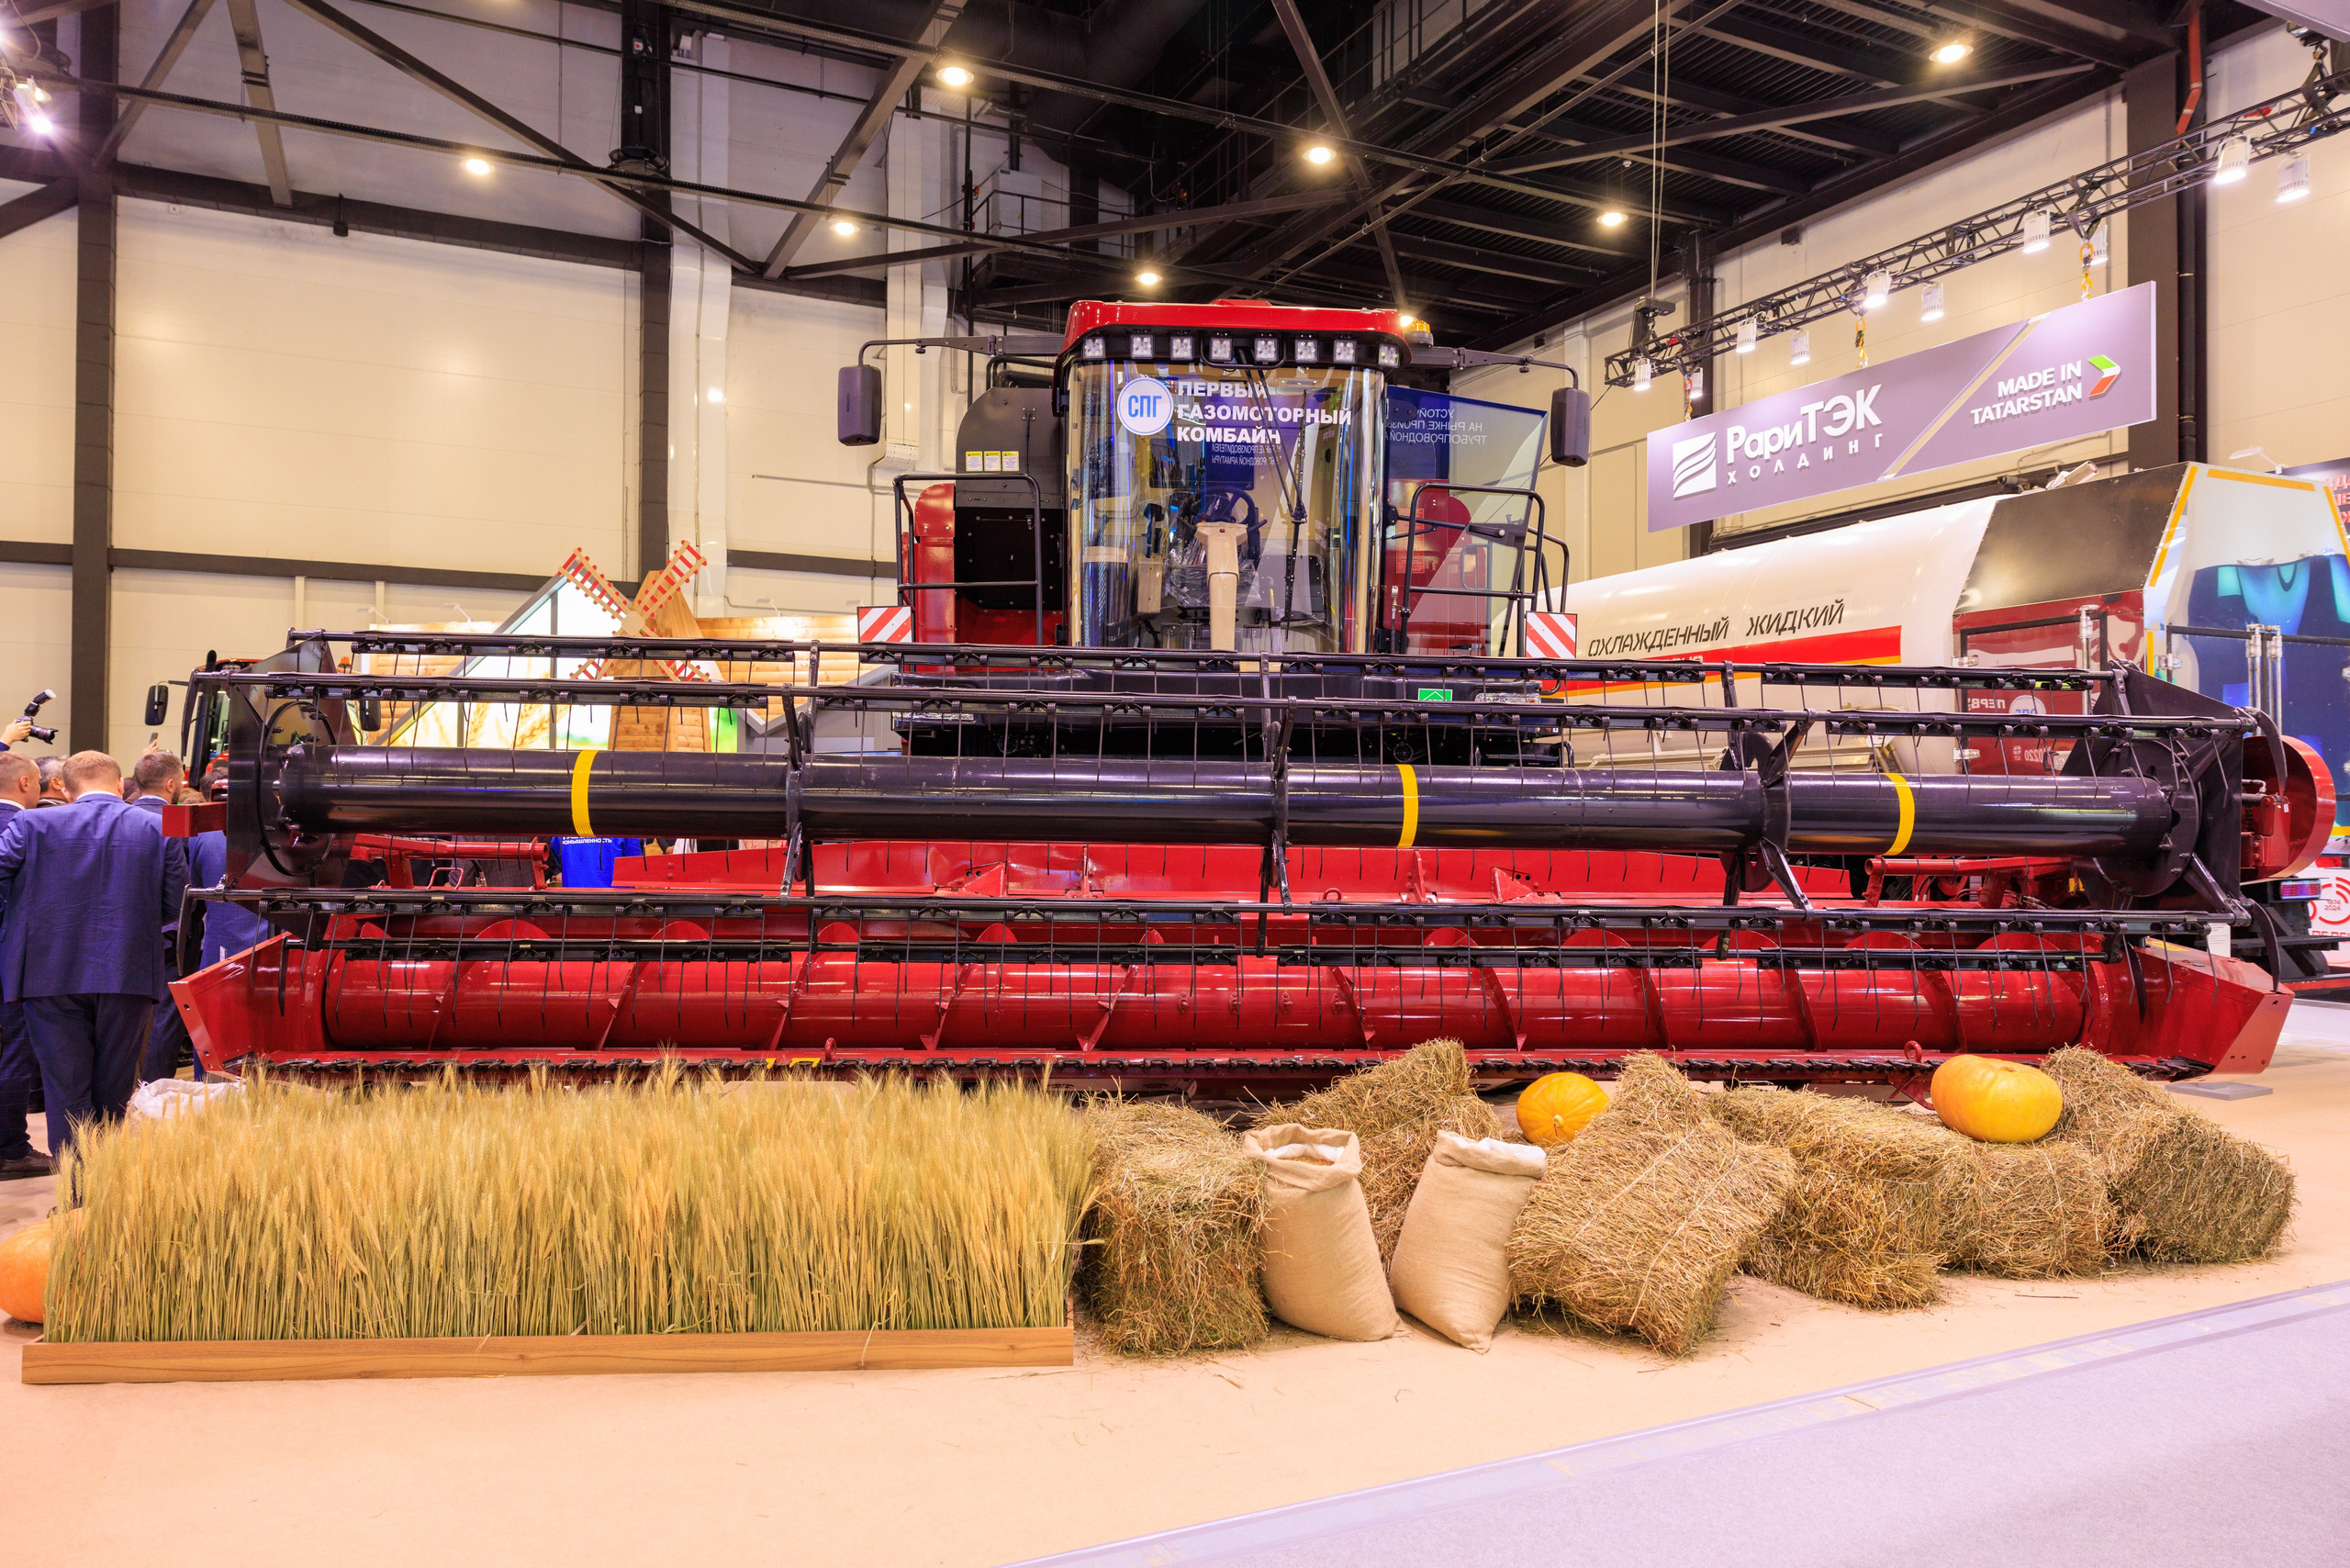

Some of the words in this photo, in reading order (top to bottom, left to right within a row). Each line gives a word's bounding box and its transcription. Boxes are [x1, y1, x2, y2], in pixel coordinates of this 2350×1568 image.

[1178, 381, 1269, 398] ПЕРВЫЙ
[1998, 367, 2055, 398] MADE
[2061, 360, 2082, 381] IN
[1127, 395, 1162, 418] СПГ
[1177, 404, 1352, 425] ГАЗОМОТОРНЫЙ
[1970, 382, 2082, 425] TATARSTAN
[1177, 425, 1281, 444] КОМБАЙН
[1727, 384, 1883, 465] РариТЭК
[1728, 433, 1883, 486] ХОЛДИНГ
[1588, 615, 1729, 657] ОХЛАЖДЕННЫЙ
[1746, 598, 1845, 637] ЖИДКИЙ
